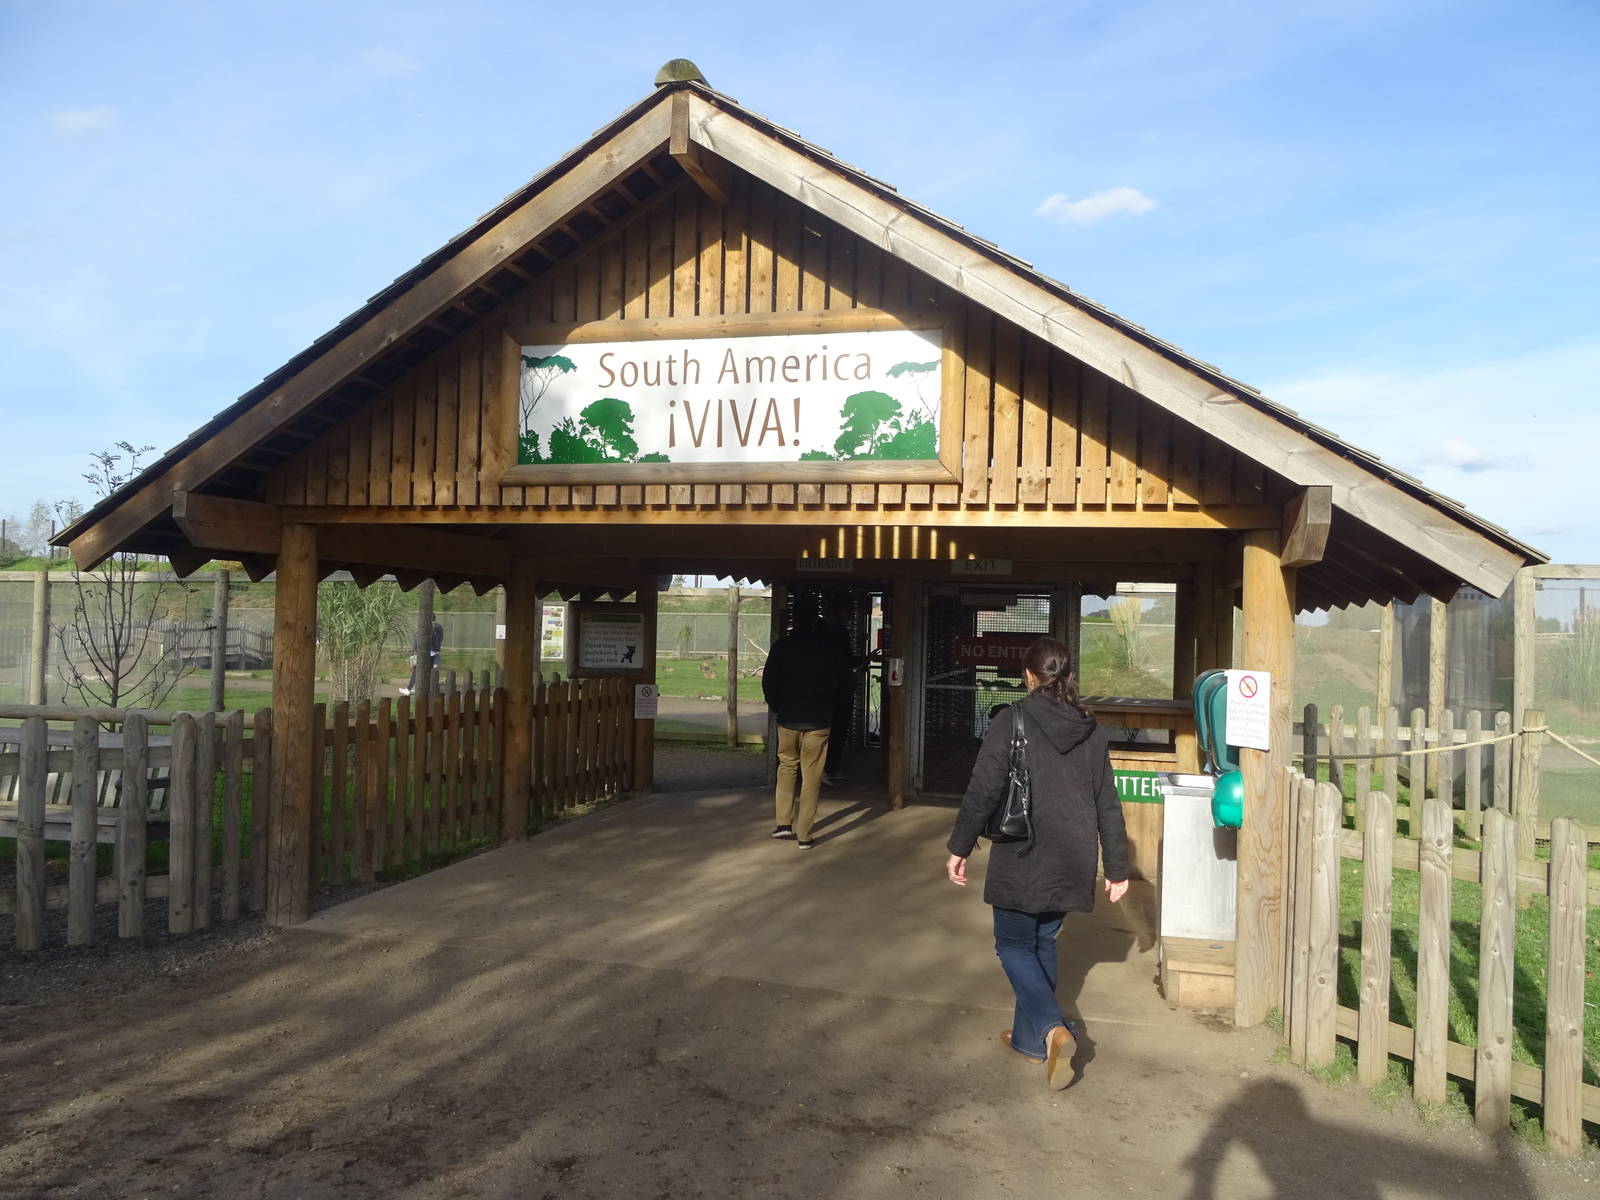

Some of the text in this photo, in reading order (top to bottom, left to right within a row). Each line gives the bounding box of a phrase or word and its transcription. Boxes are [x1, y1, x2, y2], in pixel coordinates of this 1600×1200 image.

[598, 345, 871, 388] South America
[669, 397, 801, 448] ¡VIVA!
[799, 558, 851, 569] ENTRANCE
[964, 559, 996, 571] EXIT
[960, 645, 1028, 658] NO ENTR
[1114, 776, 1161, 798] ITTER
